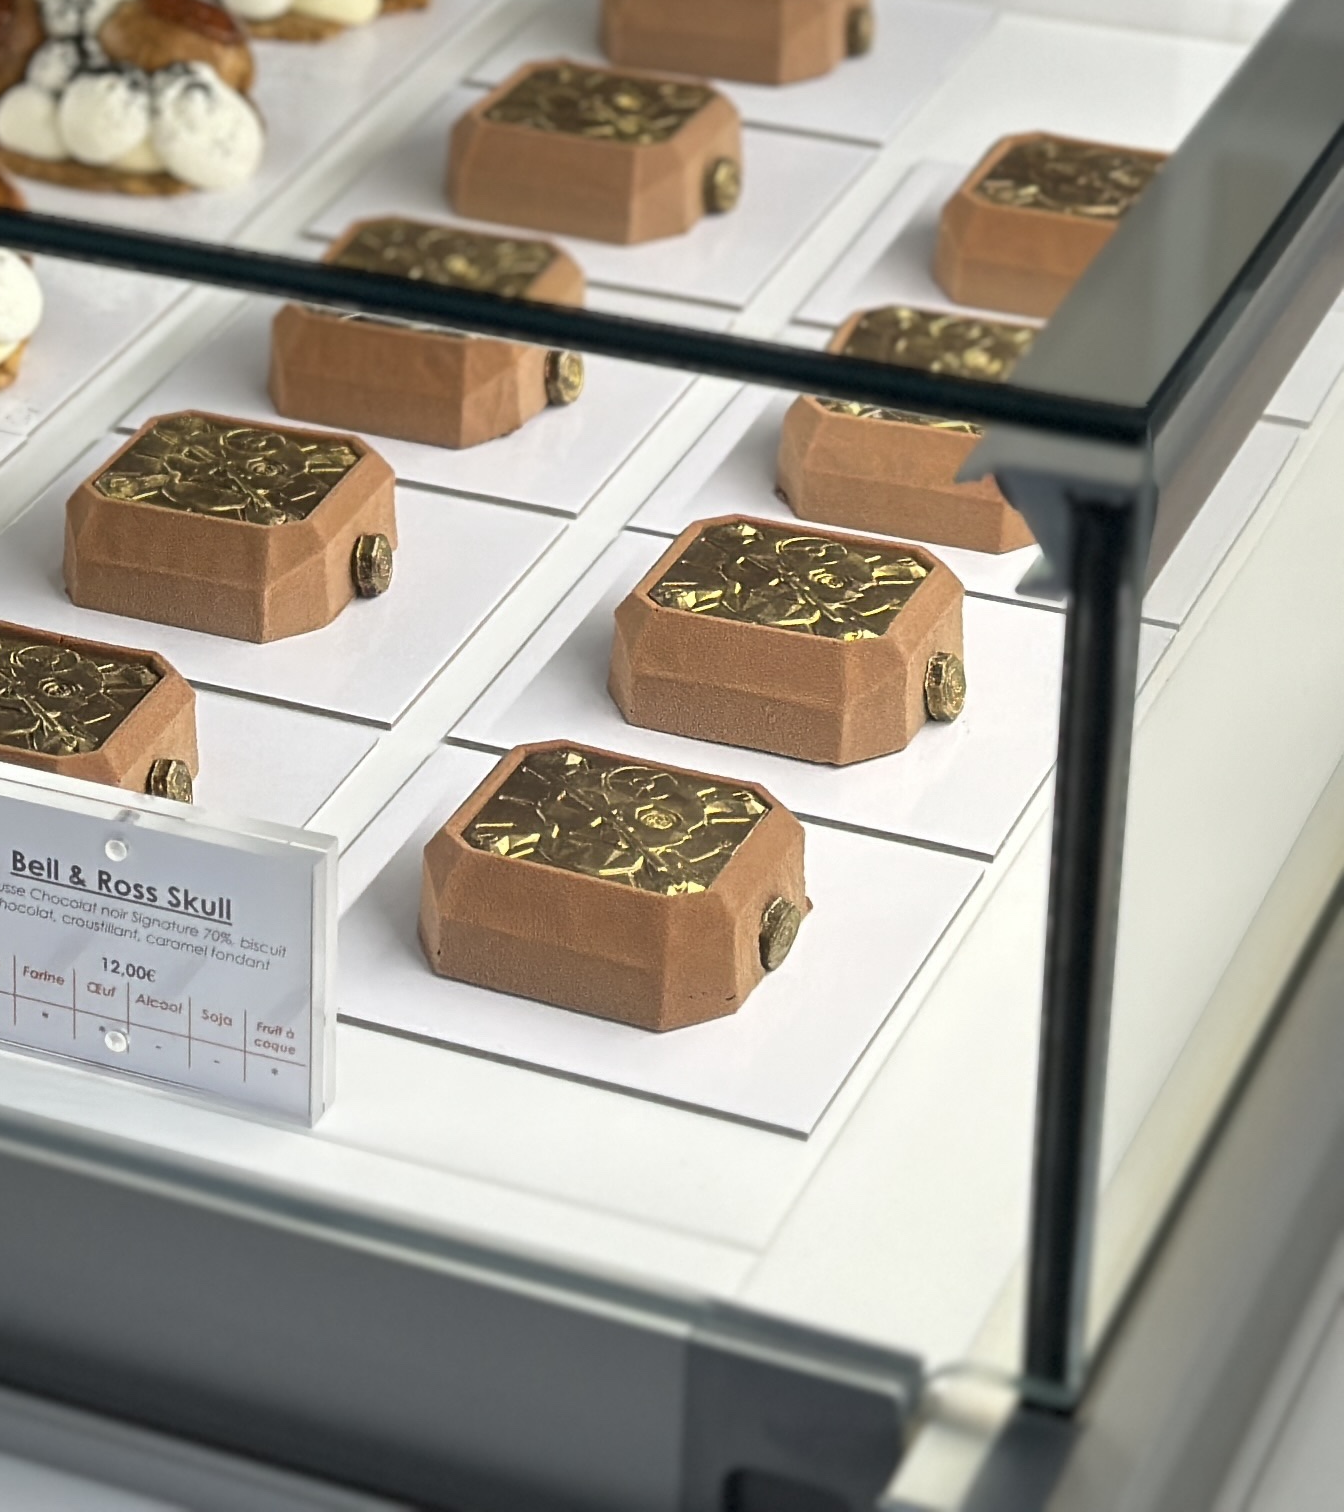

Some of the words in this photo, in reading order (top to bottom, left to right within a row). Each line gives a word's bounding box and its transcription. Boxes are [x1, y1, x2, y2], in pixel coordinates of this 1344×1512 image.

[12, 849, 59, 881] Bell
[69, 864, 87, 887] &
[97, 869, 158, 903] Ross
[167, 886, 232, 921] Skull
[29, 888, 98, 914] Chocolat
[101, 904, 128, 920] noir
[131, 911, 200, 938] Signature
[239, 936, 287, 958] biscuit
[61, 913, 141, 943] croustillant,
[146, 933, 209, 957] caramel
[212, 946, 272, 972] fondant
[22, 965, 65, 986] Farine
[87, 982, 117, 997] Œuf
[135, 993, 184, 1014] Alcool
[202, 1008, 233, 1027] Soja
[256, 1021, 283, 1037] Fruit
[253, 1037, 296, 1056] coque
